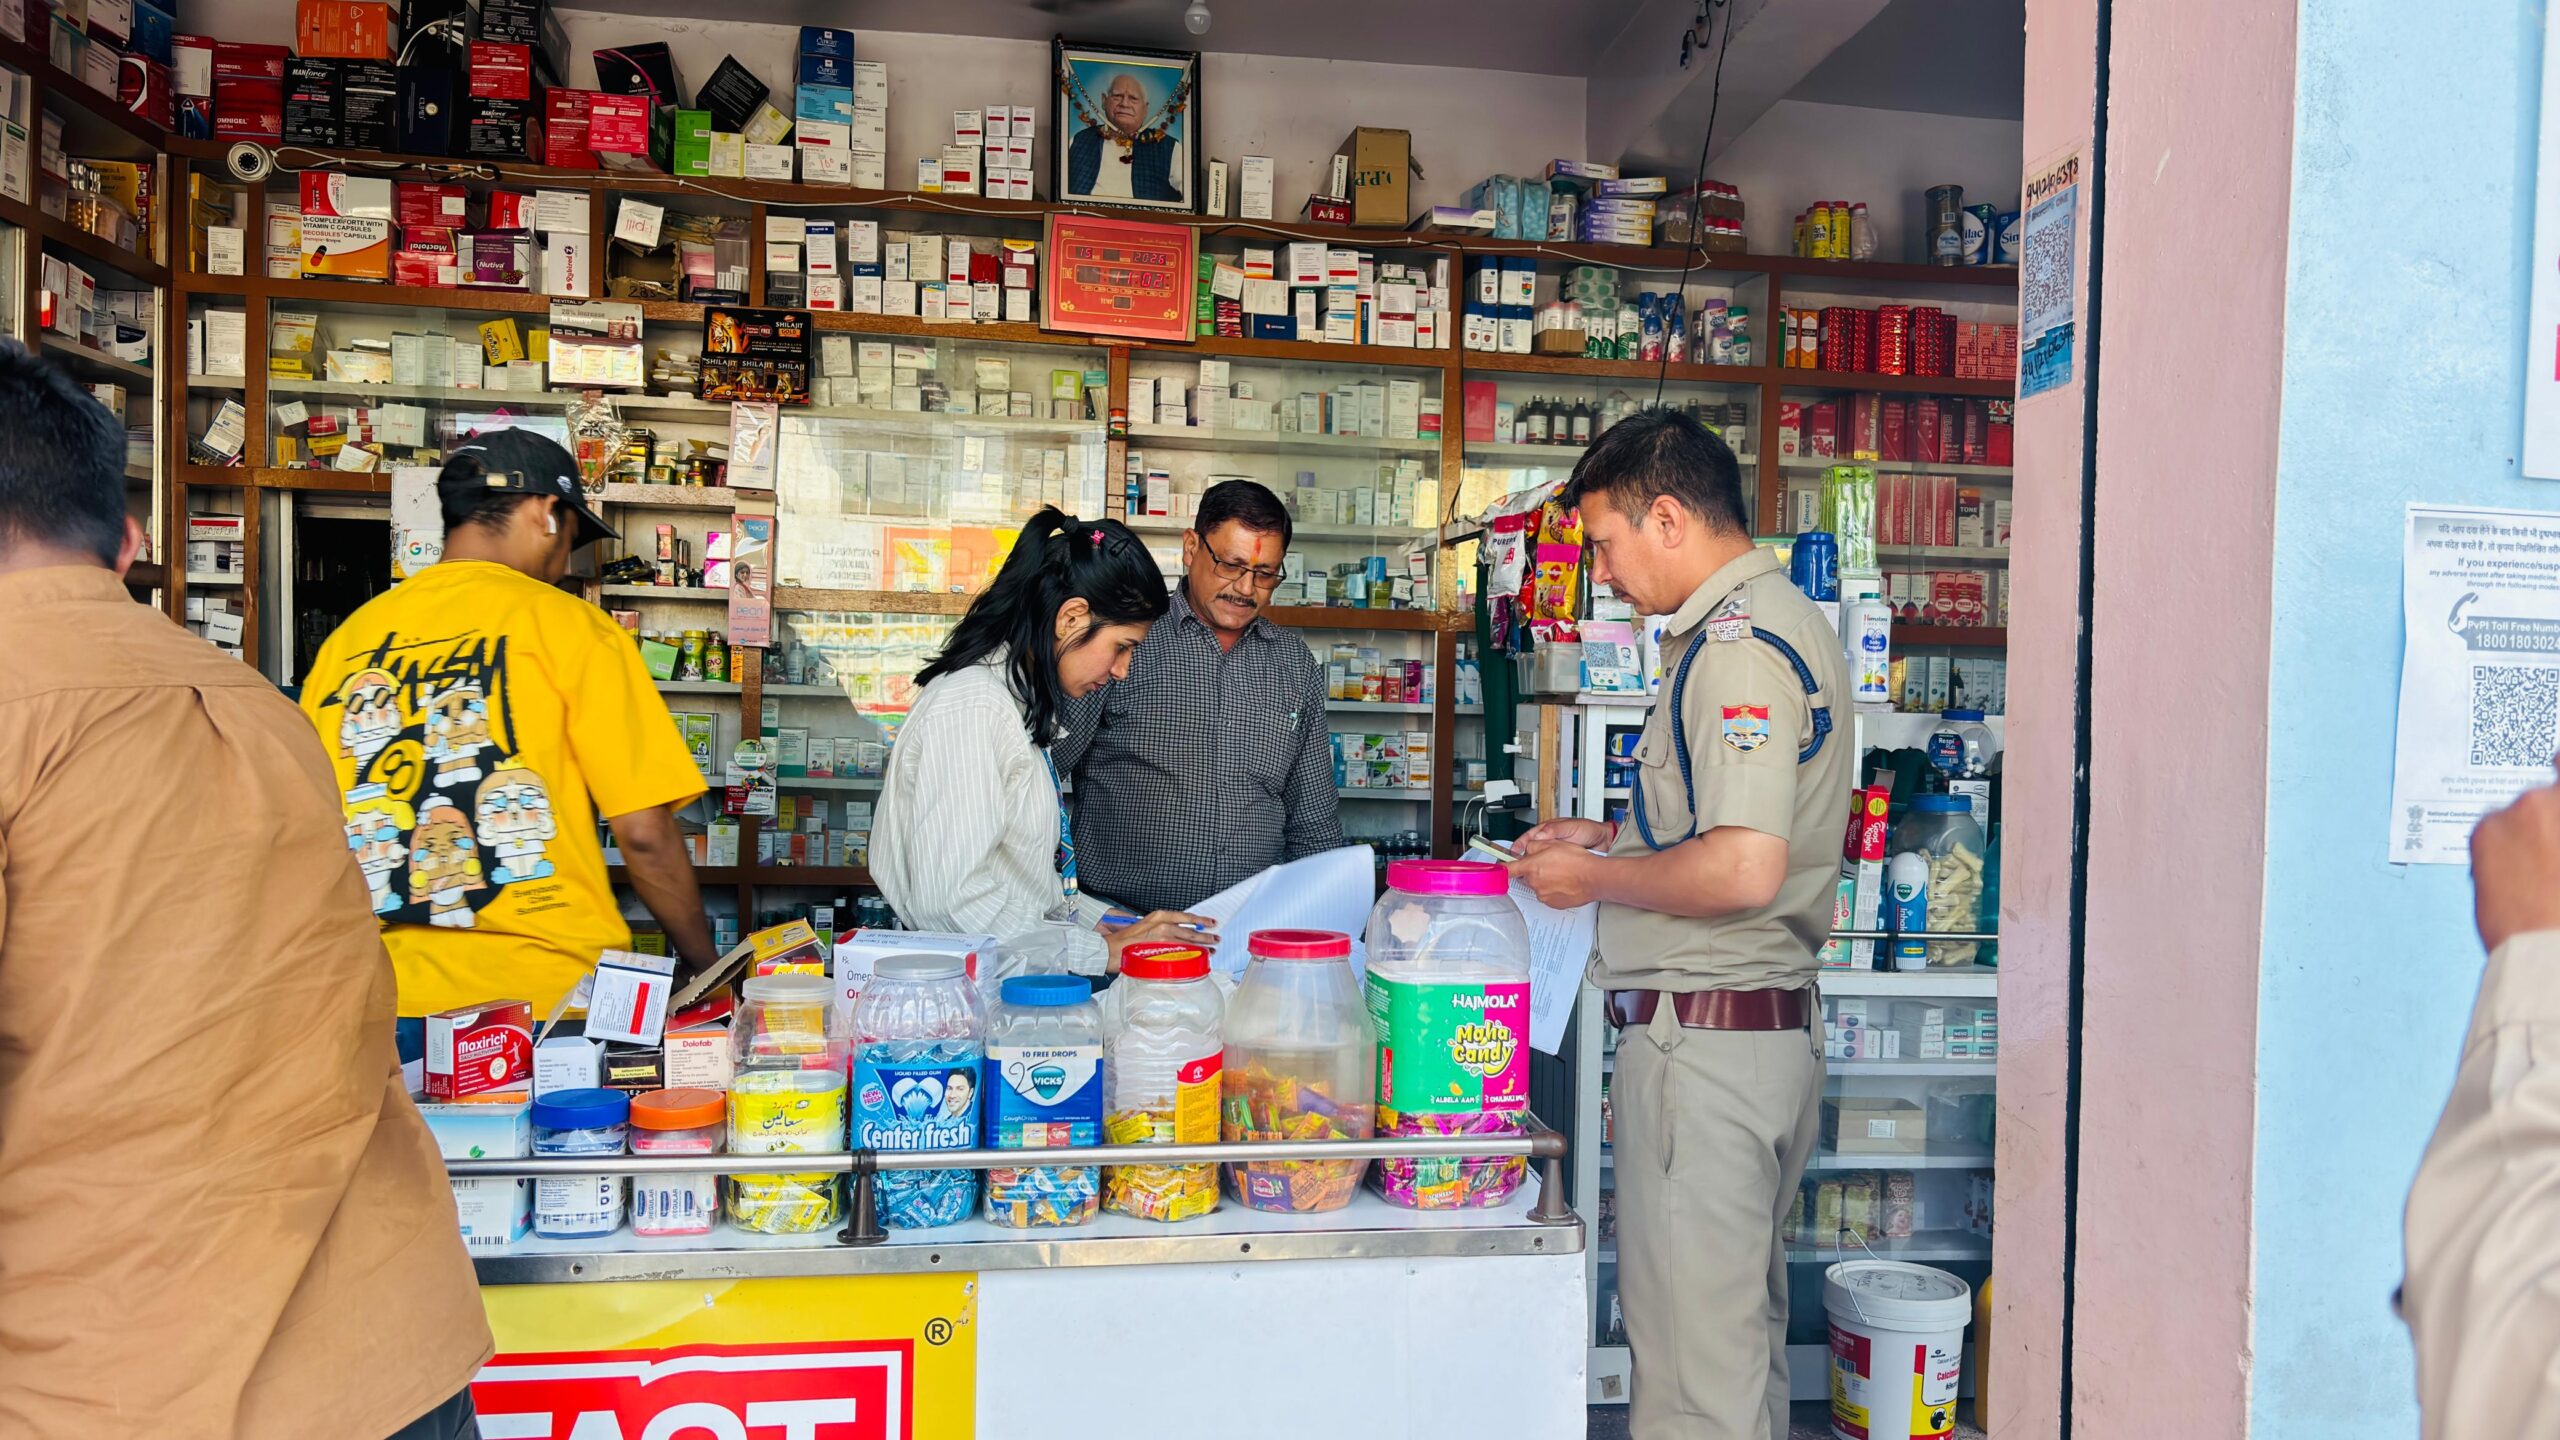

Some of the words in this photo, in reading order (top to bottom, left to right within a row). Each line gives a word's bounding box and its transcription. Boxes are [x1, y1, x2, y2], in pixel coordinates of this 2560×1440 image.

[1318, 207, 1335, 219] Avil
[1335, 212, 1344, 220] 25
[303, 222, 329, 230] VITAMIN
[337, 224, 372, 233] CAPSULES
[344, 232, 377, 240] CAPSULES
[409, 242, 448, 252] Mactotal
[1080, 248, 1092, 258] 15
[479, 260, 505, 269] Nutiva
[775, 321, 804, 329] SHILAJIT
[706, 358, 737, 367] SHILAJIT
[742, 360, 774, 369] SHILAJIT
[2466, 558, 2484, 568] you
[2492, 621, 2509, 631] Toll
[2511, 622, 2531, 632] Free
[2476, 633, 2507, 648] 1800
[2509, 634, 2531, 649] 180
[1872, 820, 1885, 844] Good
[1862, 826, 1873, 853] Knight
[1452, 993, 1517, 1011] HAJMOLA
[1456, 1020, 1510, 1047] Maha
[458, 1033, 507, 1055] Maxirich
[1453, 1041, 1514, 1076] Candy
[1033, 1076, 1064, 1086] VICKS
[1436, 1096, 1459, 1104] ALBELA
[1461, 1096, 1475, 1104] AAM
[862, 1121, 921, 1149] Center
[925, 1120, 971, 1149] fresh
